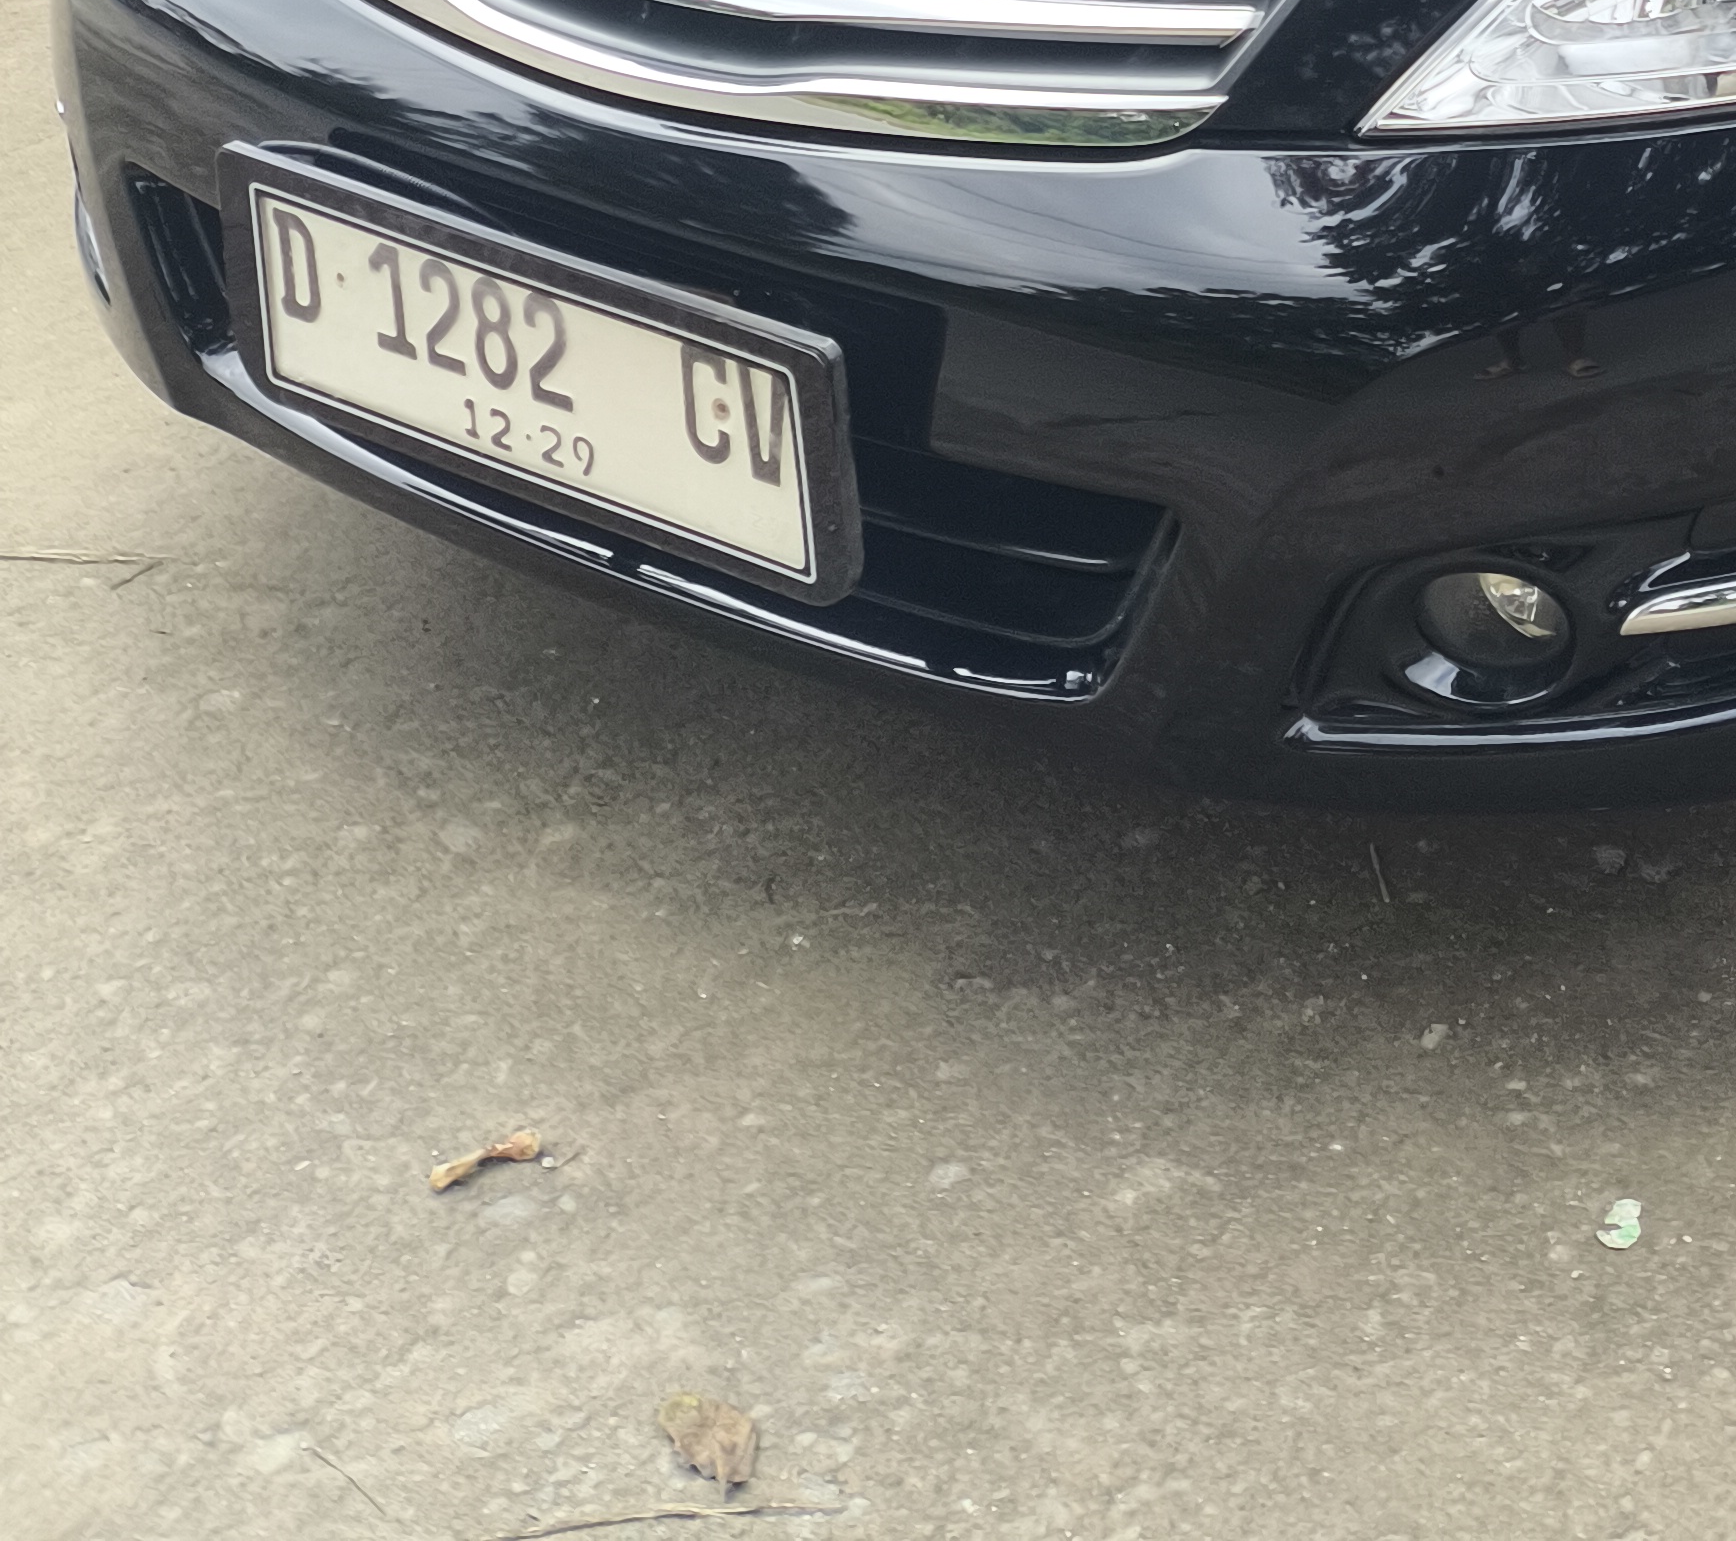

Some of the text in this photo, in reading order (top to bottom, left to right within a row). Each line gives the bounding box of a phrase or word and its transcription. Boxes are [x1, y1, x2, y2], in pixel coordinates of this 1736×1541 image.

[272, 205, 789, 489] D 1282 CV
